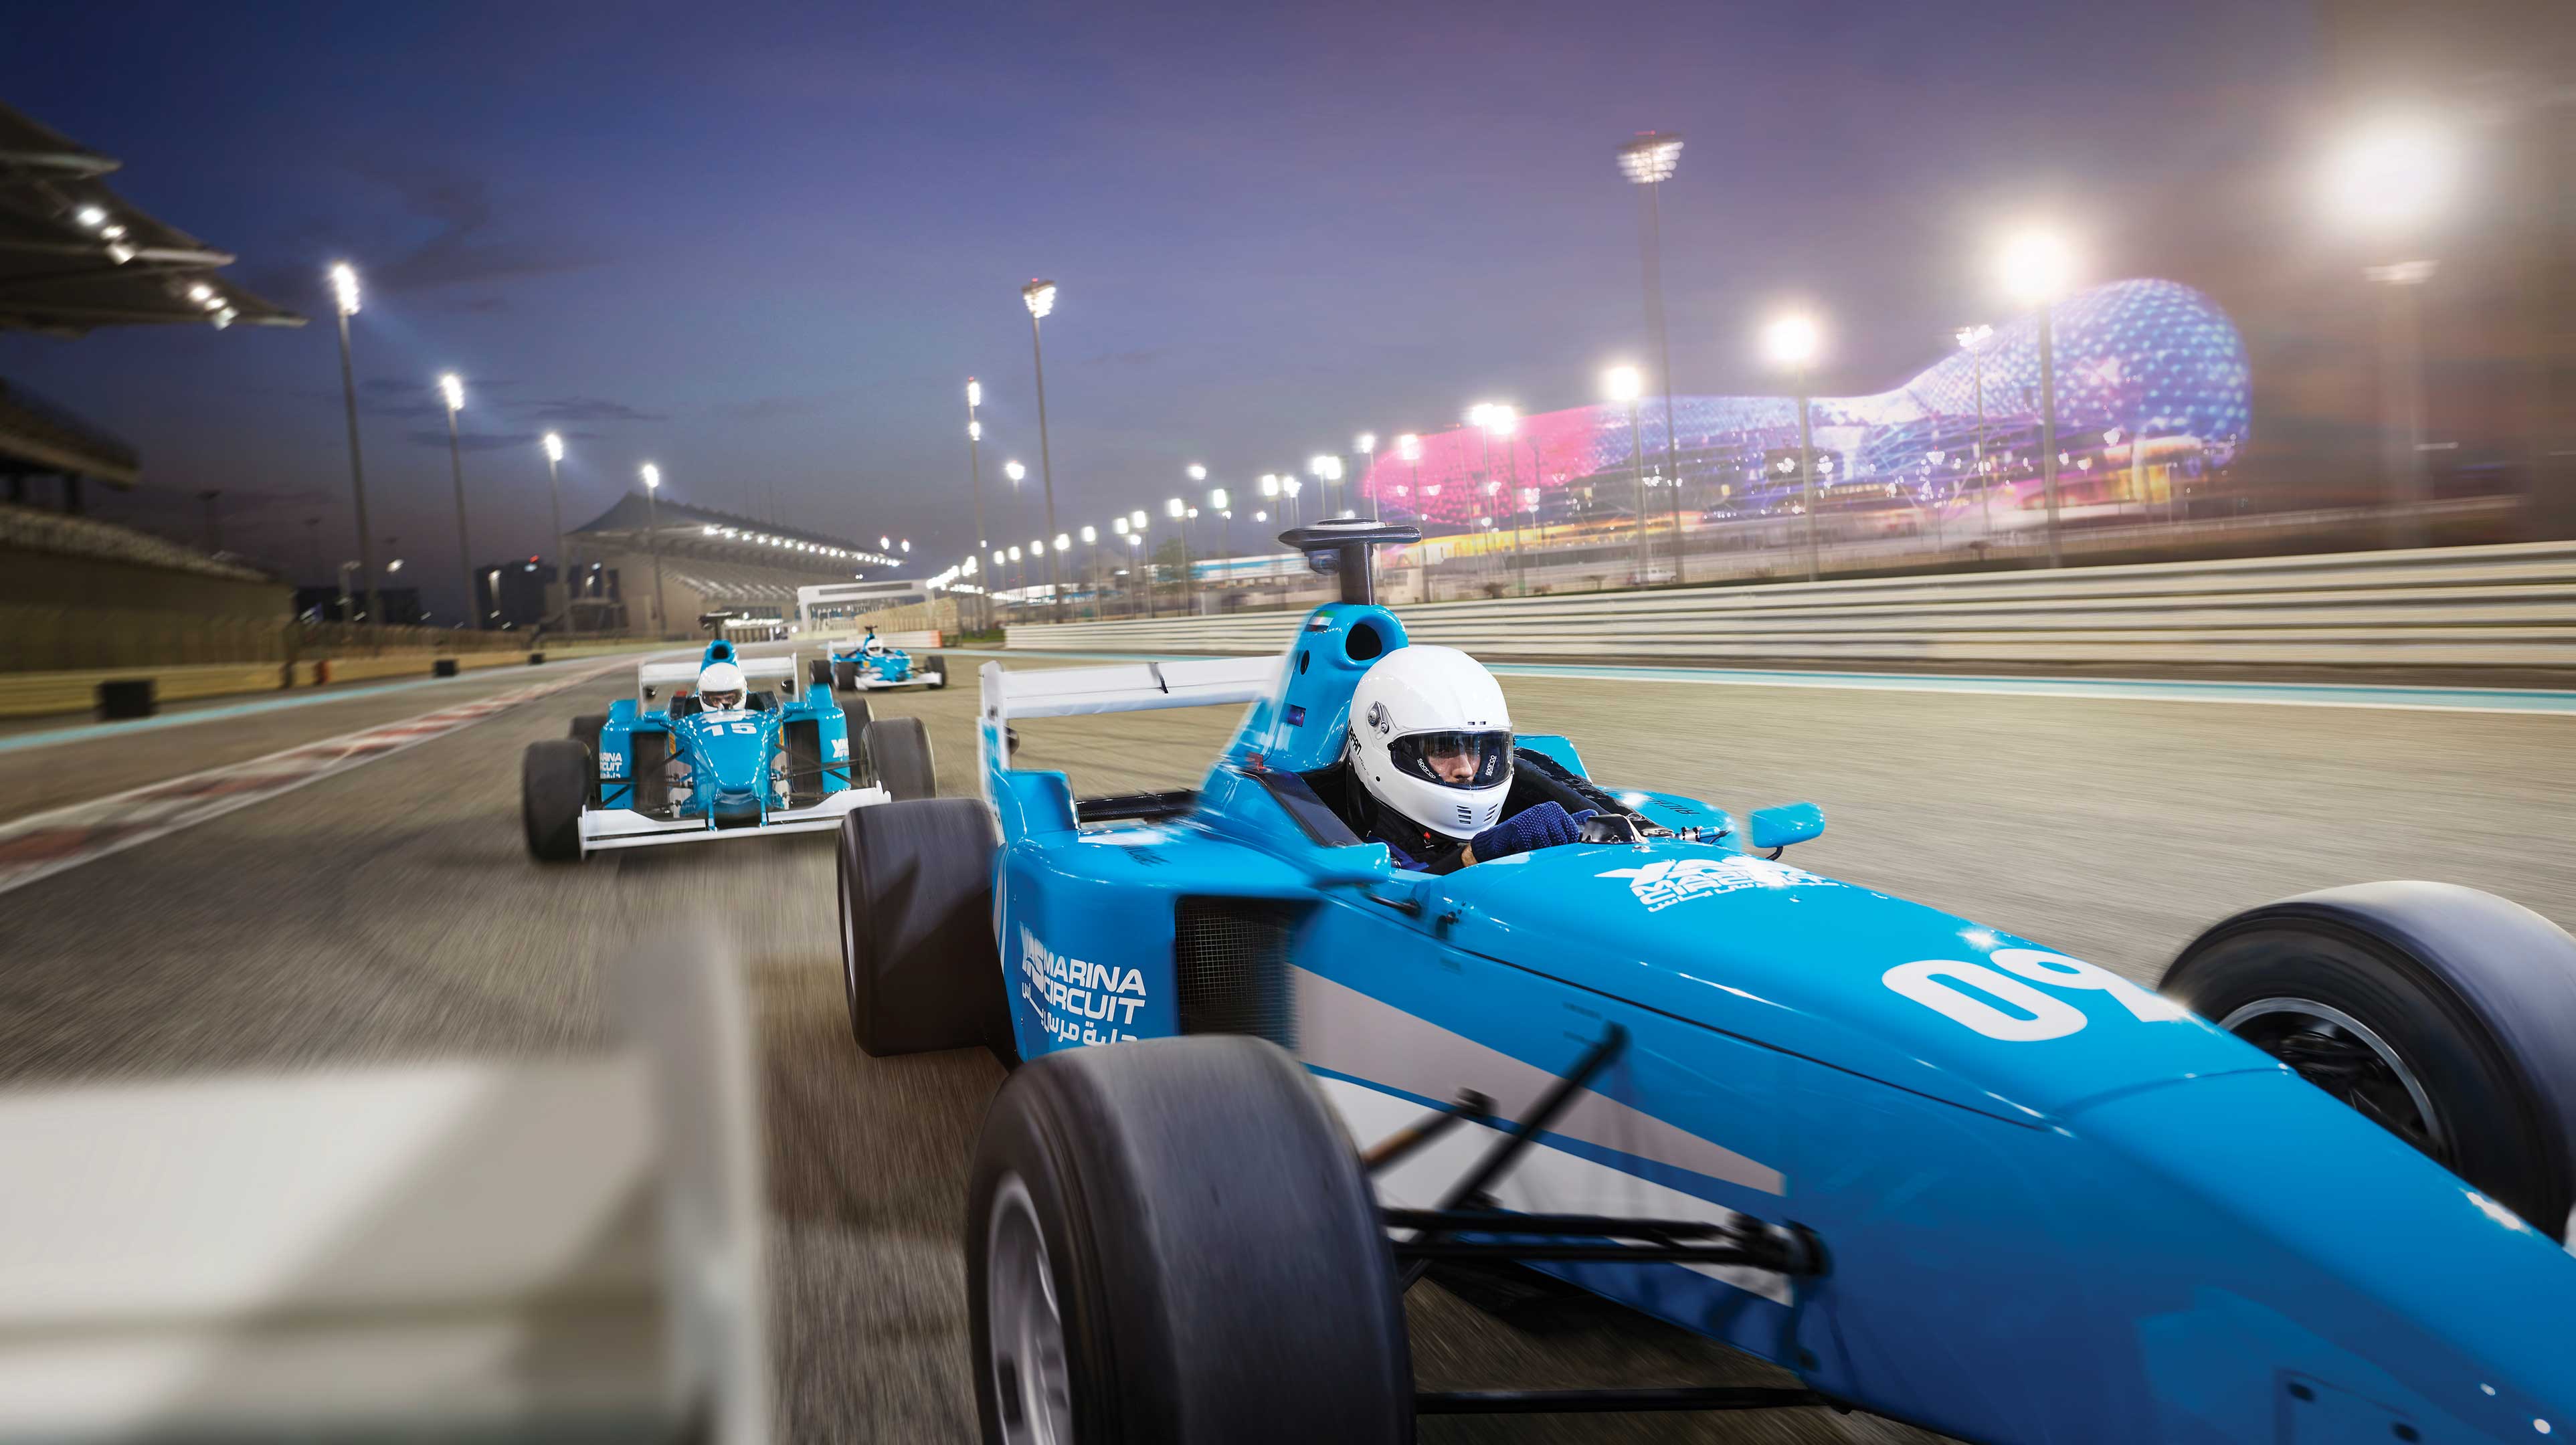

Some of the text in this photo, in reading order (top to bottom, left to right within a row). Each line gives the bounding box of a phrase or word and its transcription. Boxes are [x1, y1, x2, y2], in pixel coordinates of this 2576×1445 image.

[703, 722, 757, 737] 15
[1416, 758, 1437, 779] sparco
[1485, 755, 1497, 777] sparco
[1019, 920, 1147, 997] YAS MARINA
[1042, 975, 1146, 1025] CIRCUIT
[1881, 947, 2189, 1042] 09
